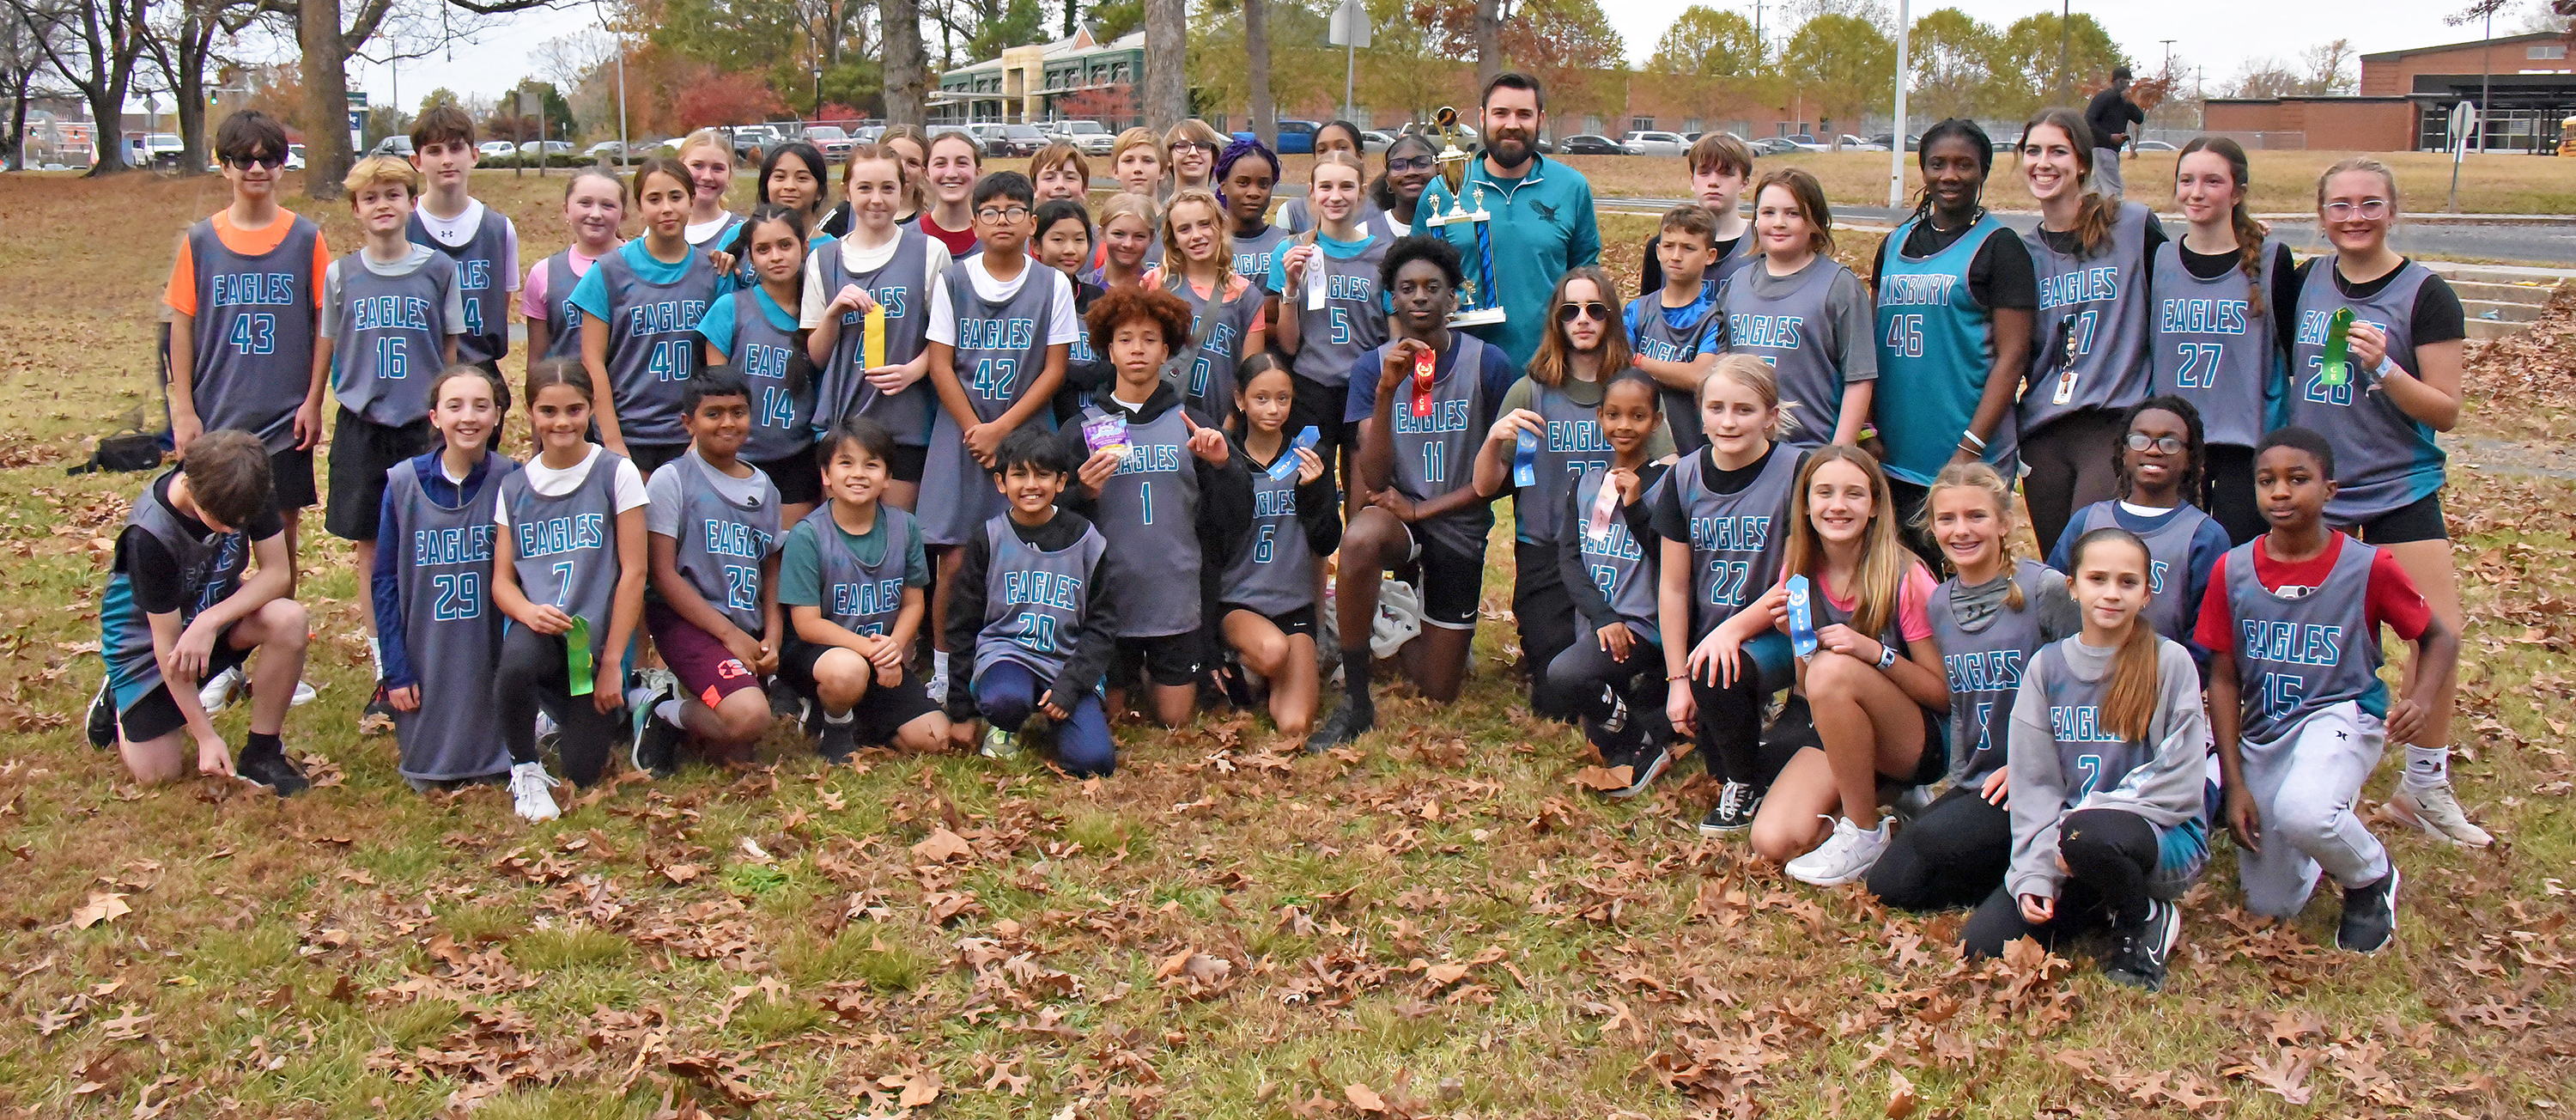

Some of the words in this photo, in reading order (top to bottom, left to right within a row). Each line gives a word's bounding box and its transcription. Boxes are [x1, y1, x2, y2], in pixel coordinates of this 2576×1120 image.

[213, 273, 294, 307] EAGLES
[458, 259, 490, 290] LES
[1324, 274, 1371, 303] GLES
[2039, 266, 2118, 311] EAGLES
[229, 313, 276, 355] 43
[354, 295, 430, 332] EAGLES
[463, 297, 483, 337] 4
[629, 300, 706, 338] EAGLES
[958, 318, 1034, 350] EAGLES
[1330, 306, 1351, 344] 5
[1729, 313, 1804, 350] EAGLES
[2160, 298, 2250, 335] EAGLES
[1886, 313, 1923, 358] 46
[376, 336, 408, 380] 16
[648, 339, 692, 382] 40
[744, 344, 793, 380] EAG
[972, 358, 1017, 400] 42
[1188, 356, 1212, 399] 0
[2176, 342, 2224, 389] 27
[2304, 355, 2354, 407] 28
[761, 386, 796, 429] 14
[1423, 441, 1444, 483] 11
[1140, 481, 1153, 525] 1
[416, 525, 497, 567] EAGLES
[518, 513, 604, 559] EAGLES
[705, 519, 773, 563] EAGLES
[1253, 524, 1276, 563] 6
[1691, 515, 1771, 552] EAGLES
[433, 572, 482, 622] 29
[551, 560, 574, 608] 7
[724, 563, 757, 612] 25
[833, 577, 904, 617] EAGLES
[1004, 569, 1084, 612] EAGLES
[1710, 559, 1749, 606] 22
[1016, 612, 1057, 654] 20
[2242, 619, 2342, 667] EAGLES
[1944, 649, 2021, 694] EAGLES
[2263, 672, 2304, 721] 15
[2077, 754, 2102, 808] 2
